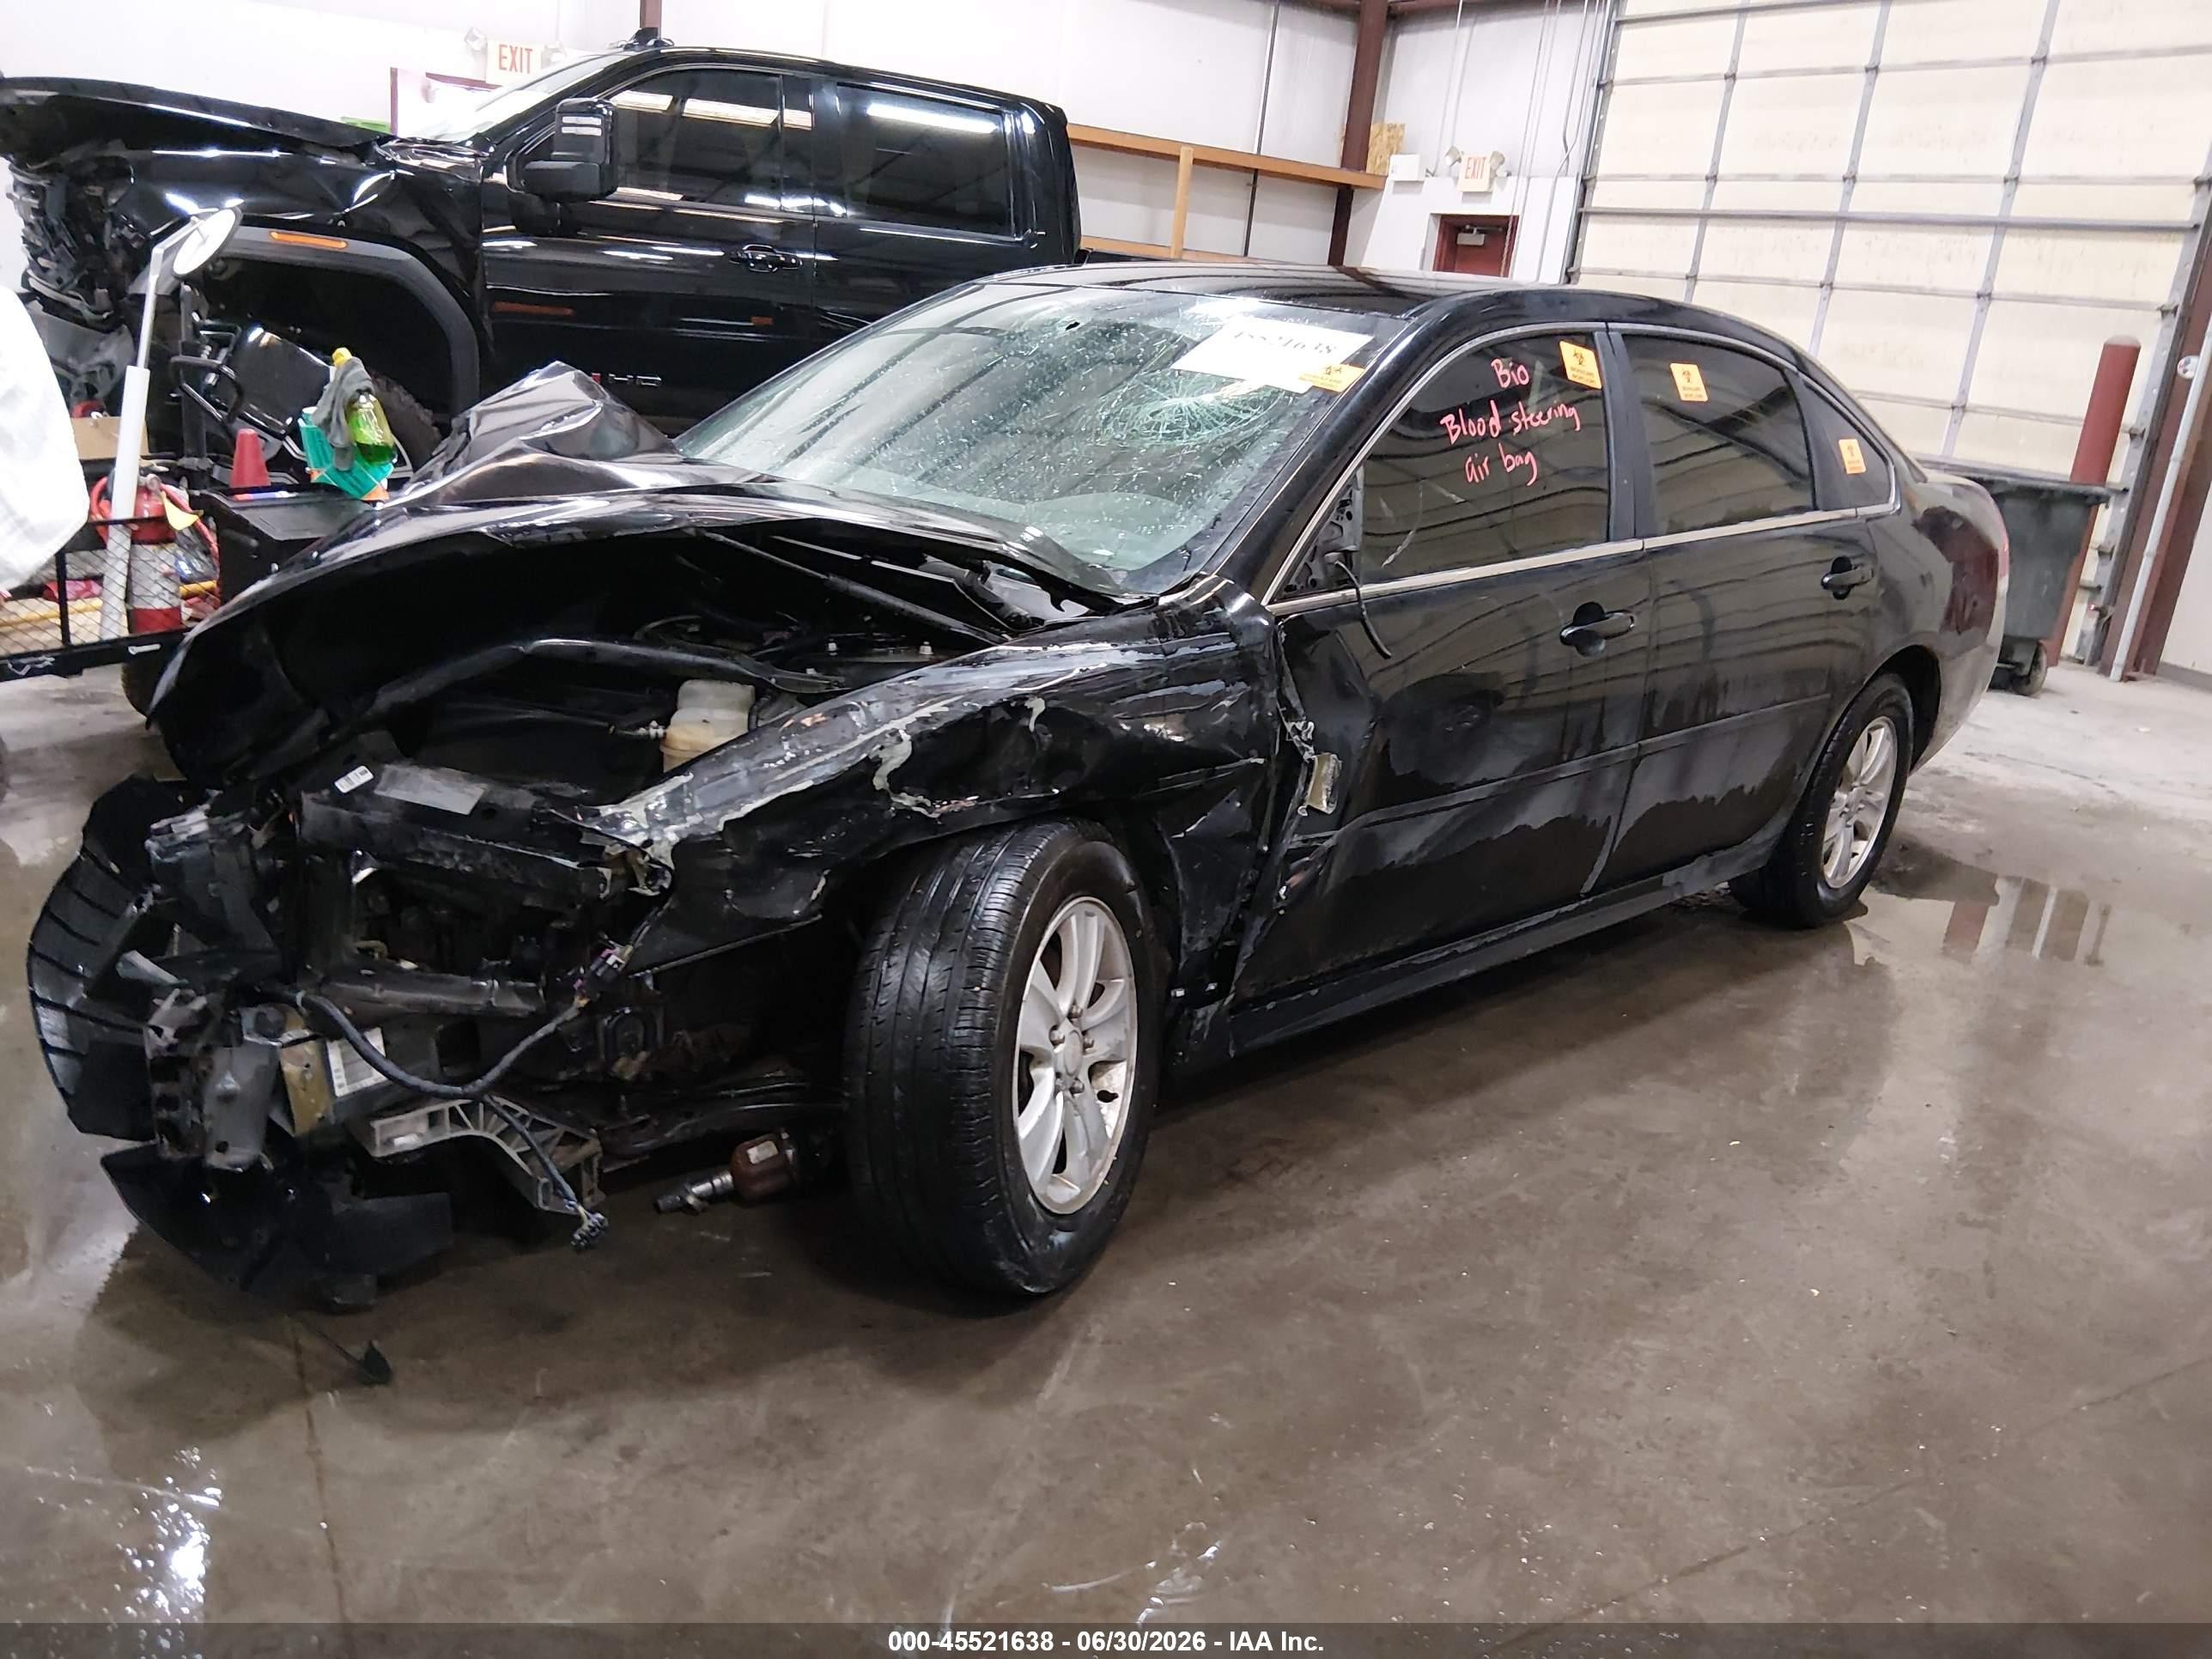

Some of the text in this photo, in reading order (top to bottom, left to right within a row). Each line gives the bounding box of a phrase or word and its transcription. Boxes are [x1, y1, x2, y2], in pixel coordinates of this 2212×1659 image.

[498, 44, 533, 75] EXIT
[1464, 156, 1488, 179] EXIT
[1491, 357, 1530, 388] Bio
[1439, 399, 1581, 445] Blood steering
[1465, 442, 1538, 487] air bag
